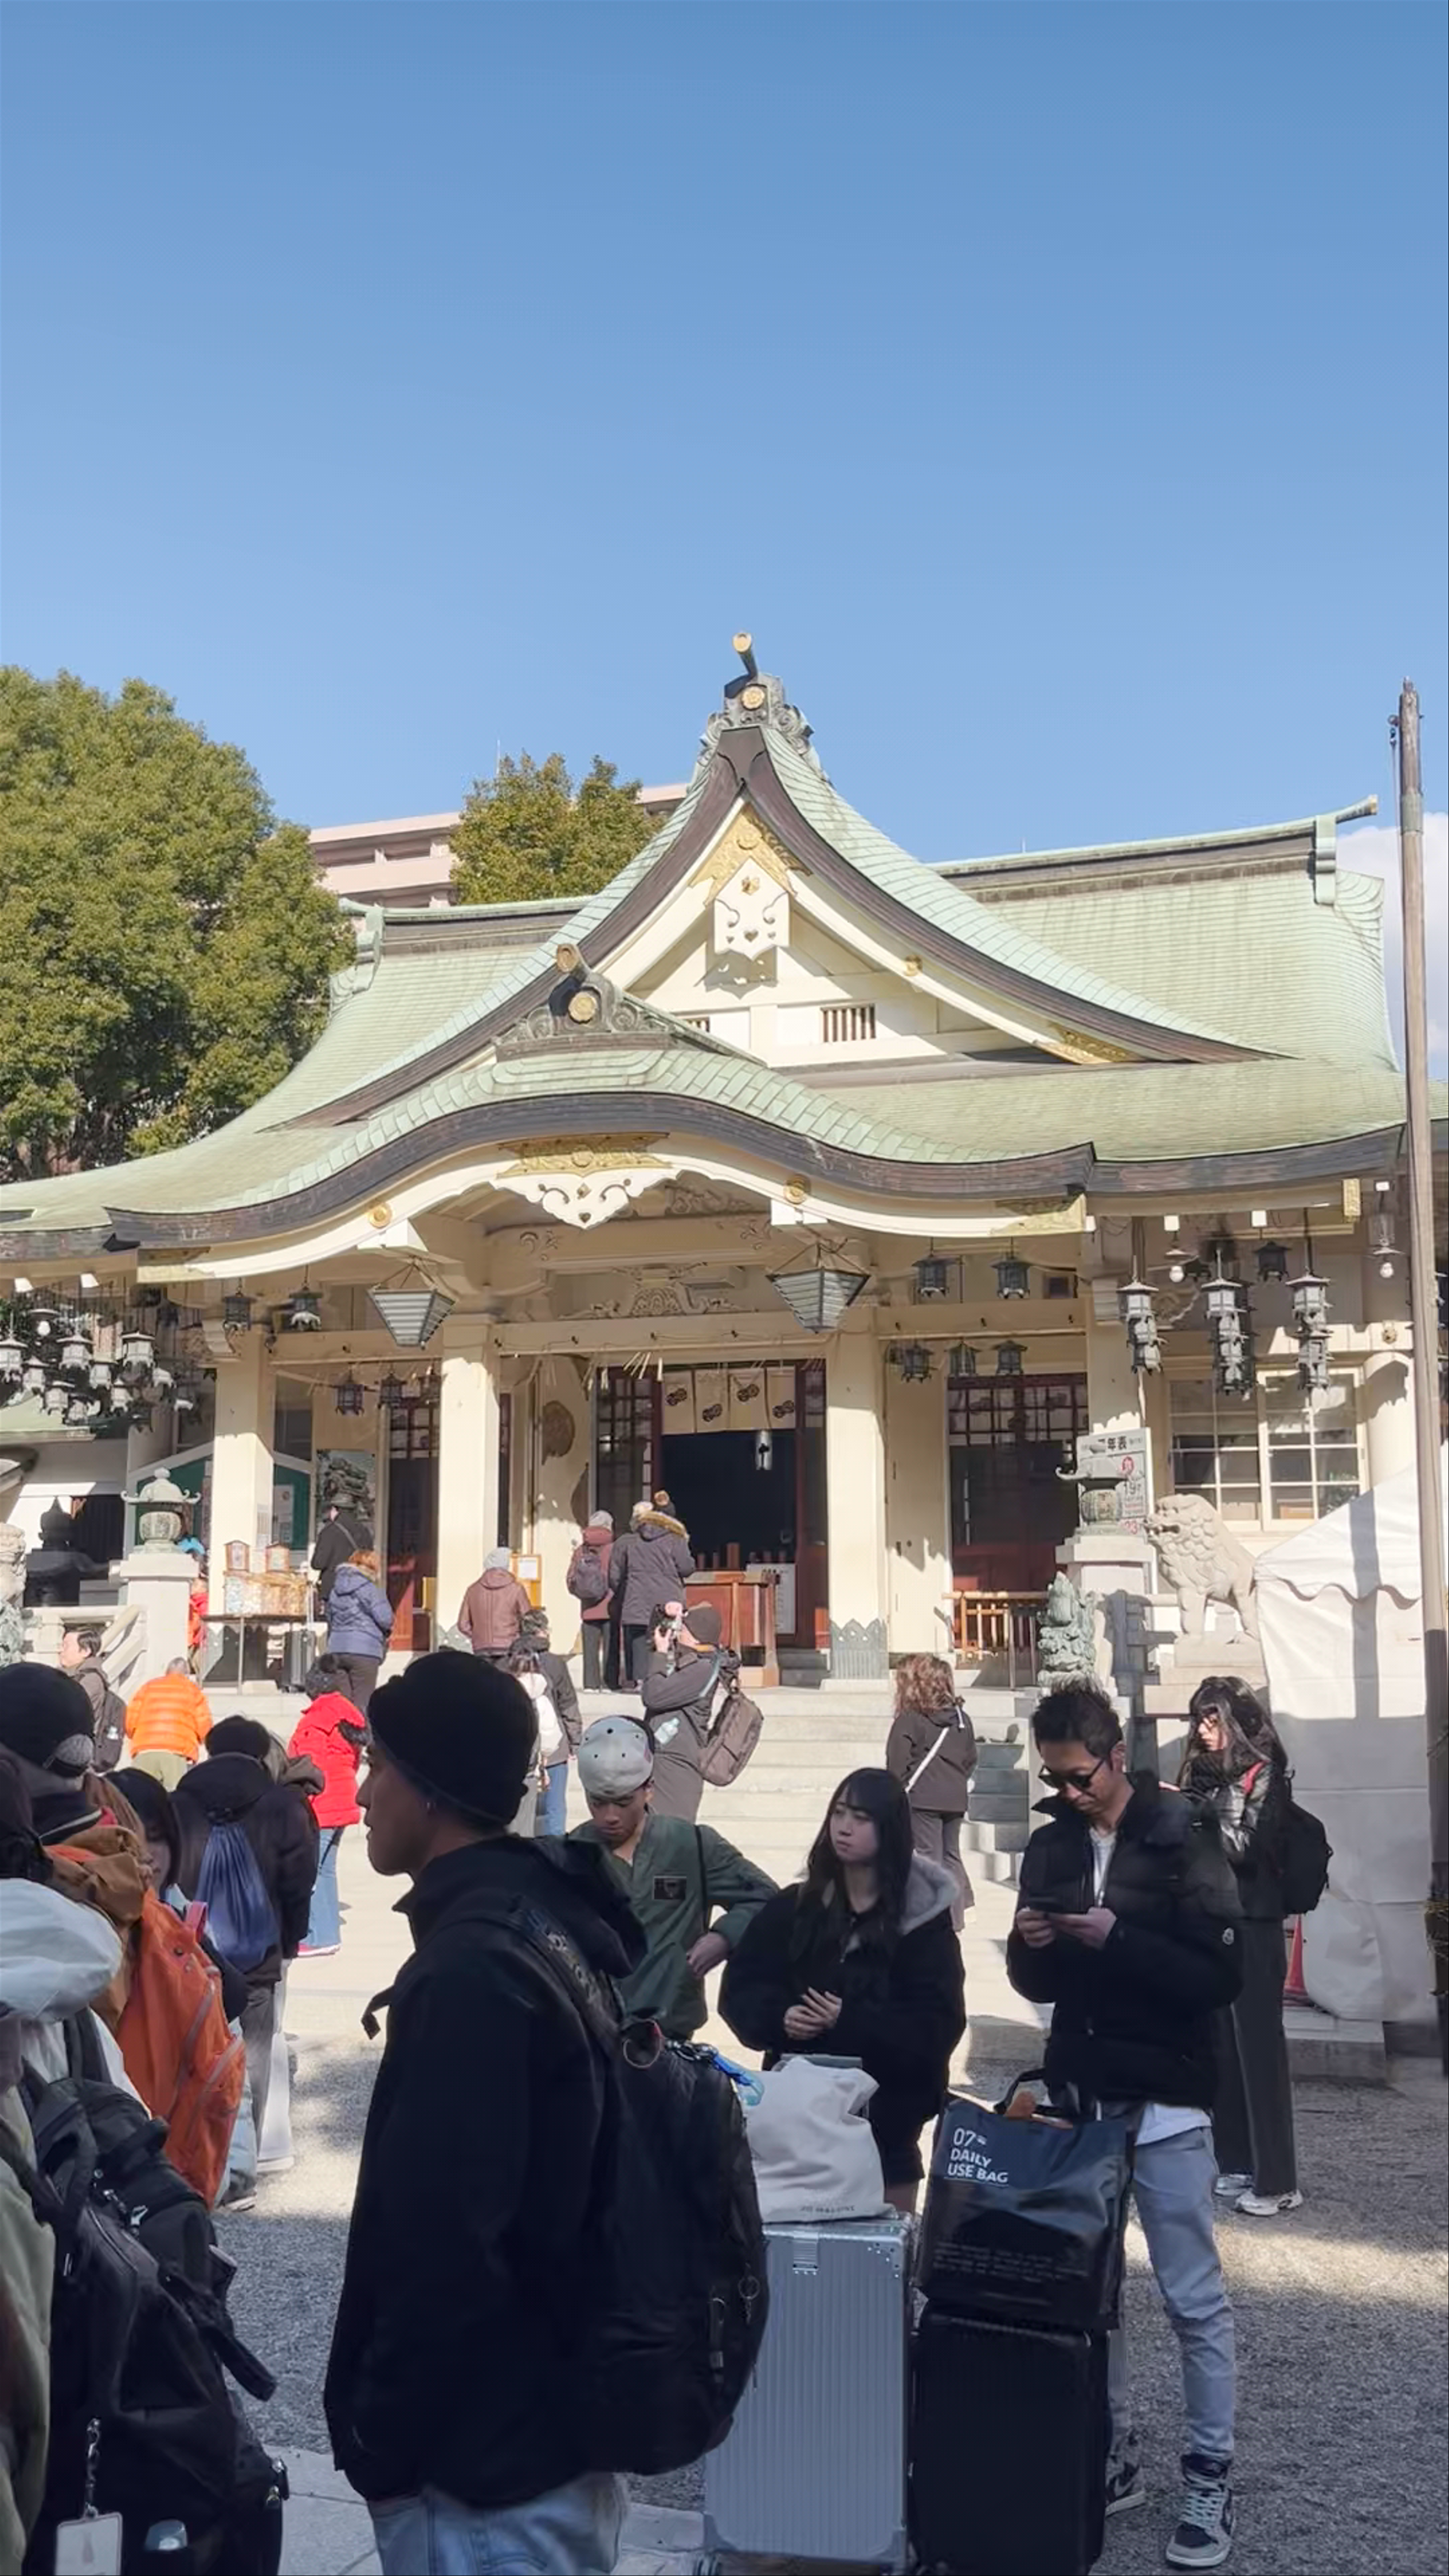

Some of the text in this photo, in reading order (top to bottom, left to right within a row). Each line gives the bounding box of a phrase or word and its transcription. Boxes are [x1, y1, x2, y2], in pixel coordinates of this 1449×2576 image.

[953, 2127, 977, 2146] 07
[950, 2148, 992, 2168] DAILY
[947, 2162, 1008, 2183] USE BAG
